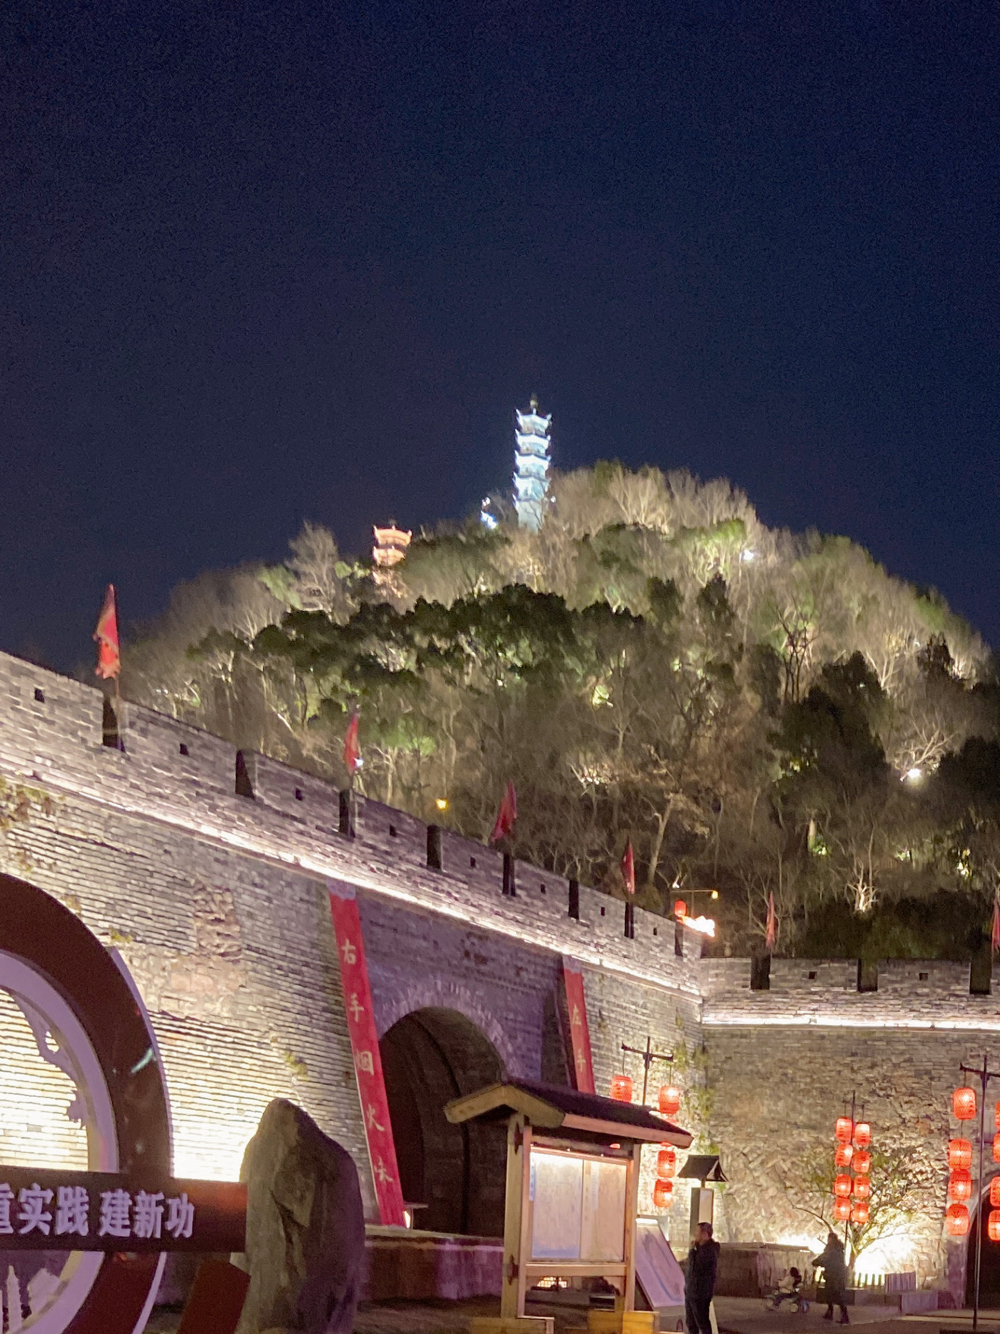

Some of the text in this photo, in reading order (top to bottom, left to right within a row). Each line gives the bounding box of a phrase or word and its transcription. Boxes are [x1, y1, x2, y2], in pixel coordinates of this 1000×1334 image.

[341, 939, 394, 1182] 右手烟火味
[99, 1189, 195, 1238] 建新功
